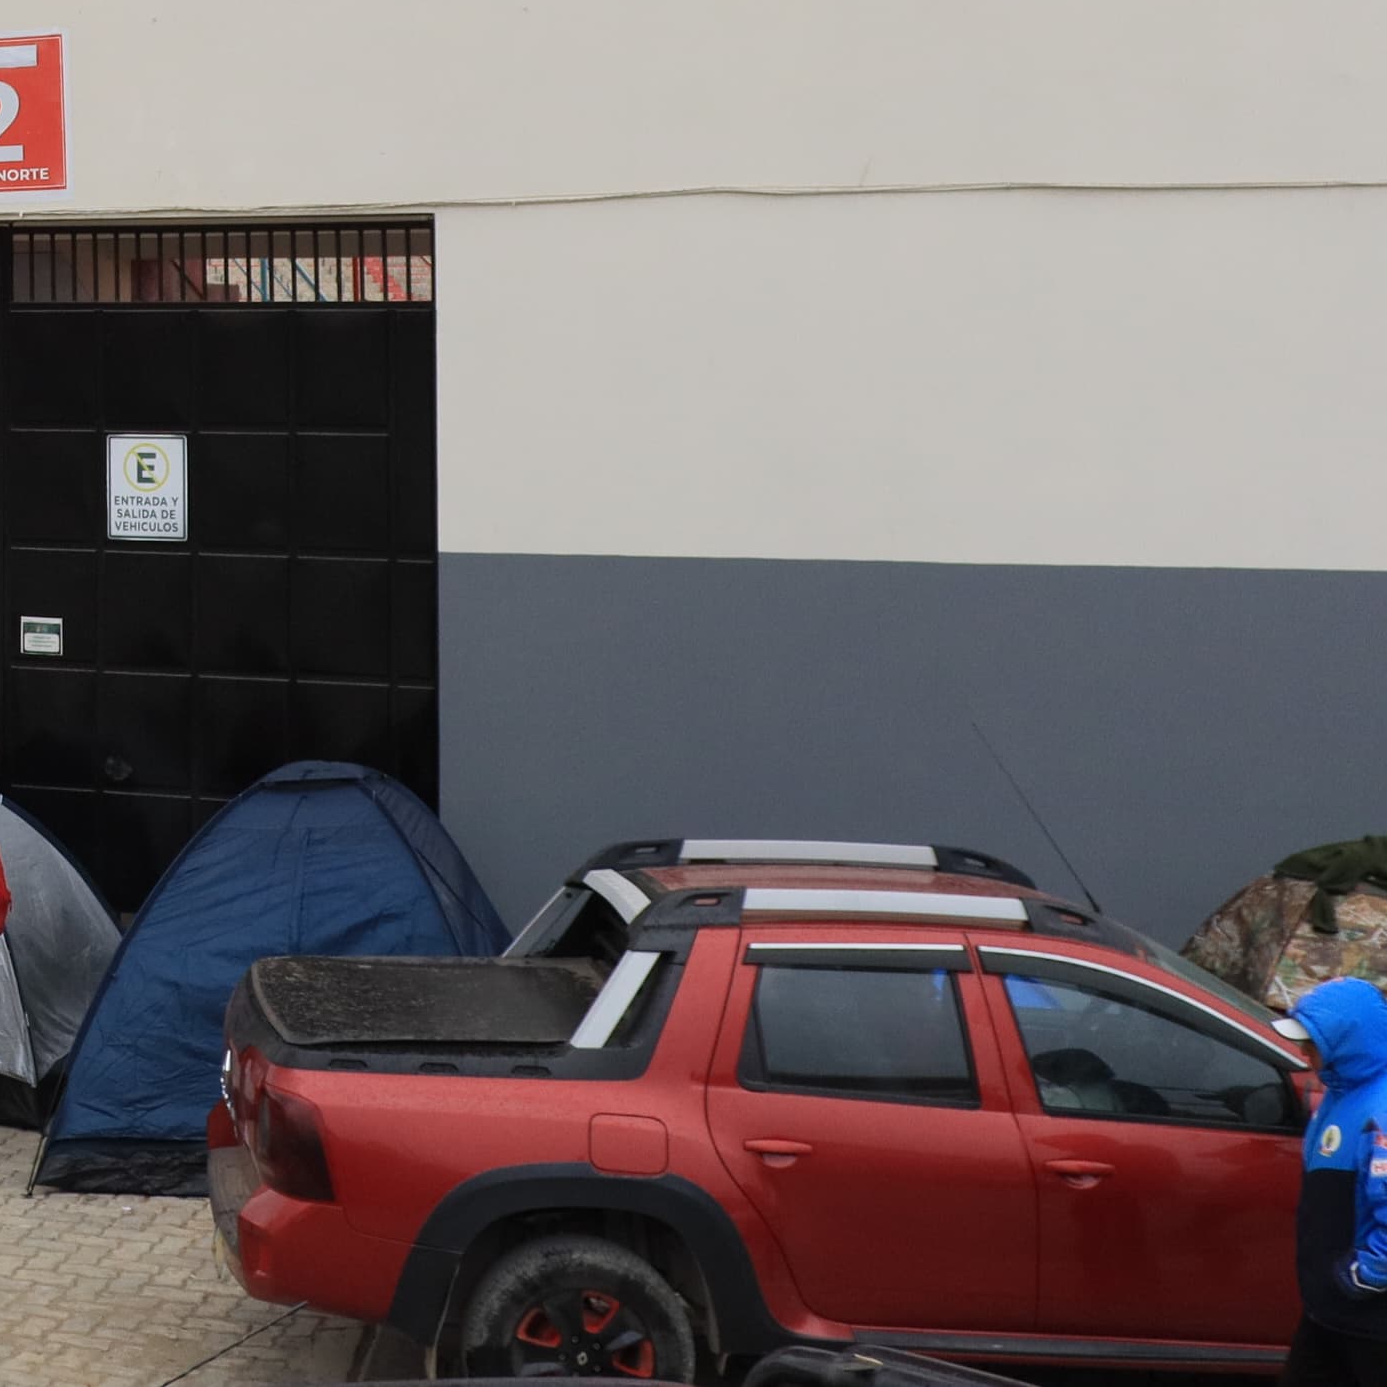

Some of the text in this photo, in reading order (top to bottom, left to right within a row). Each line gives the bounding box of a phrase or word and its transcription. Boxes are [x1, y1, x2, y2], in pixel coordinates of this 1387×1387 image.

[114, 495, 179, 506] ENTRADA Y
[116, 508, 176, 520] SALIDA DE
[114, 521, 179, 533] VEHICULOS
